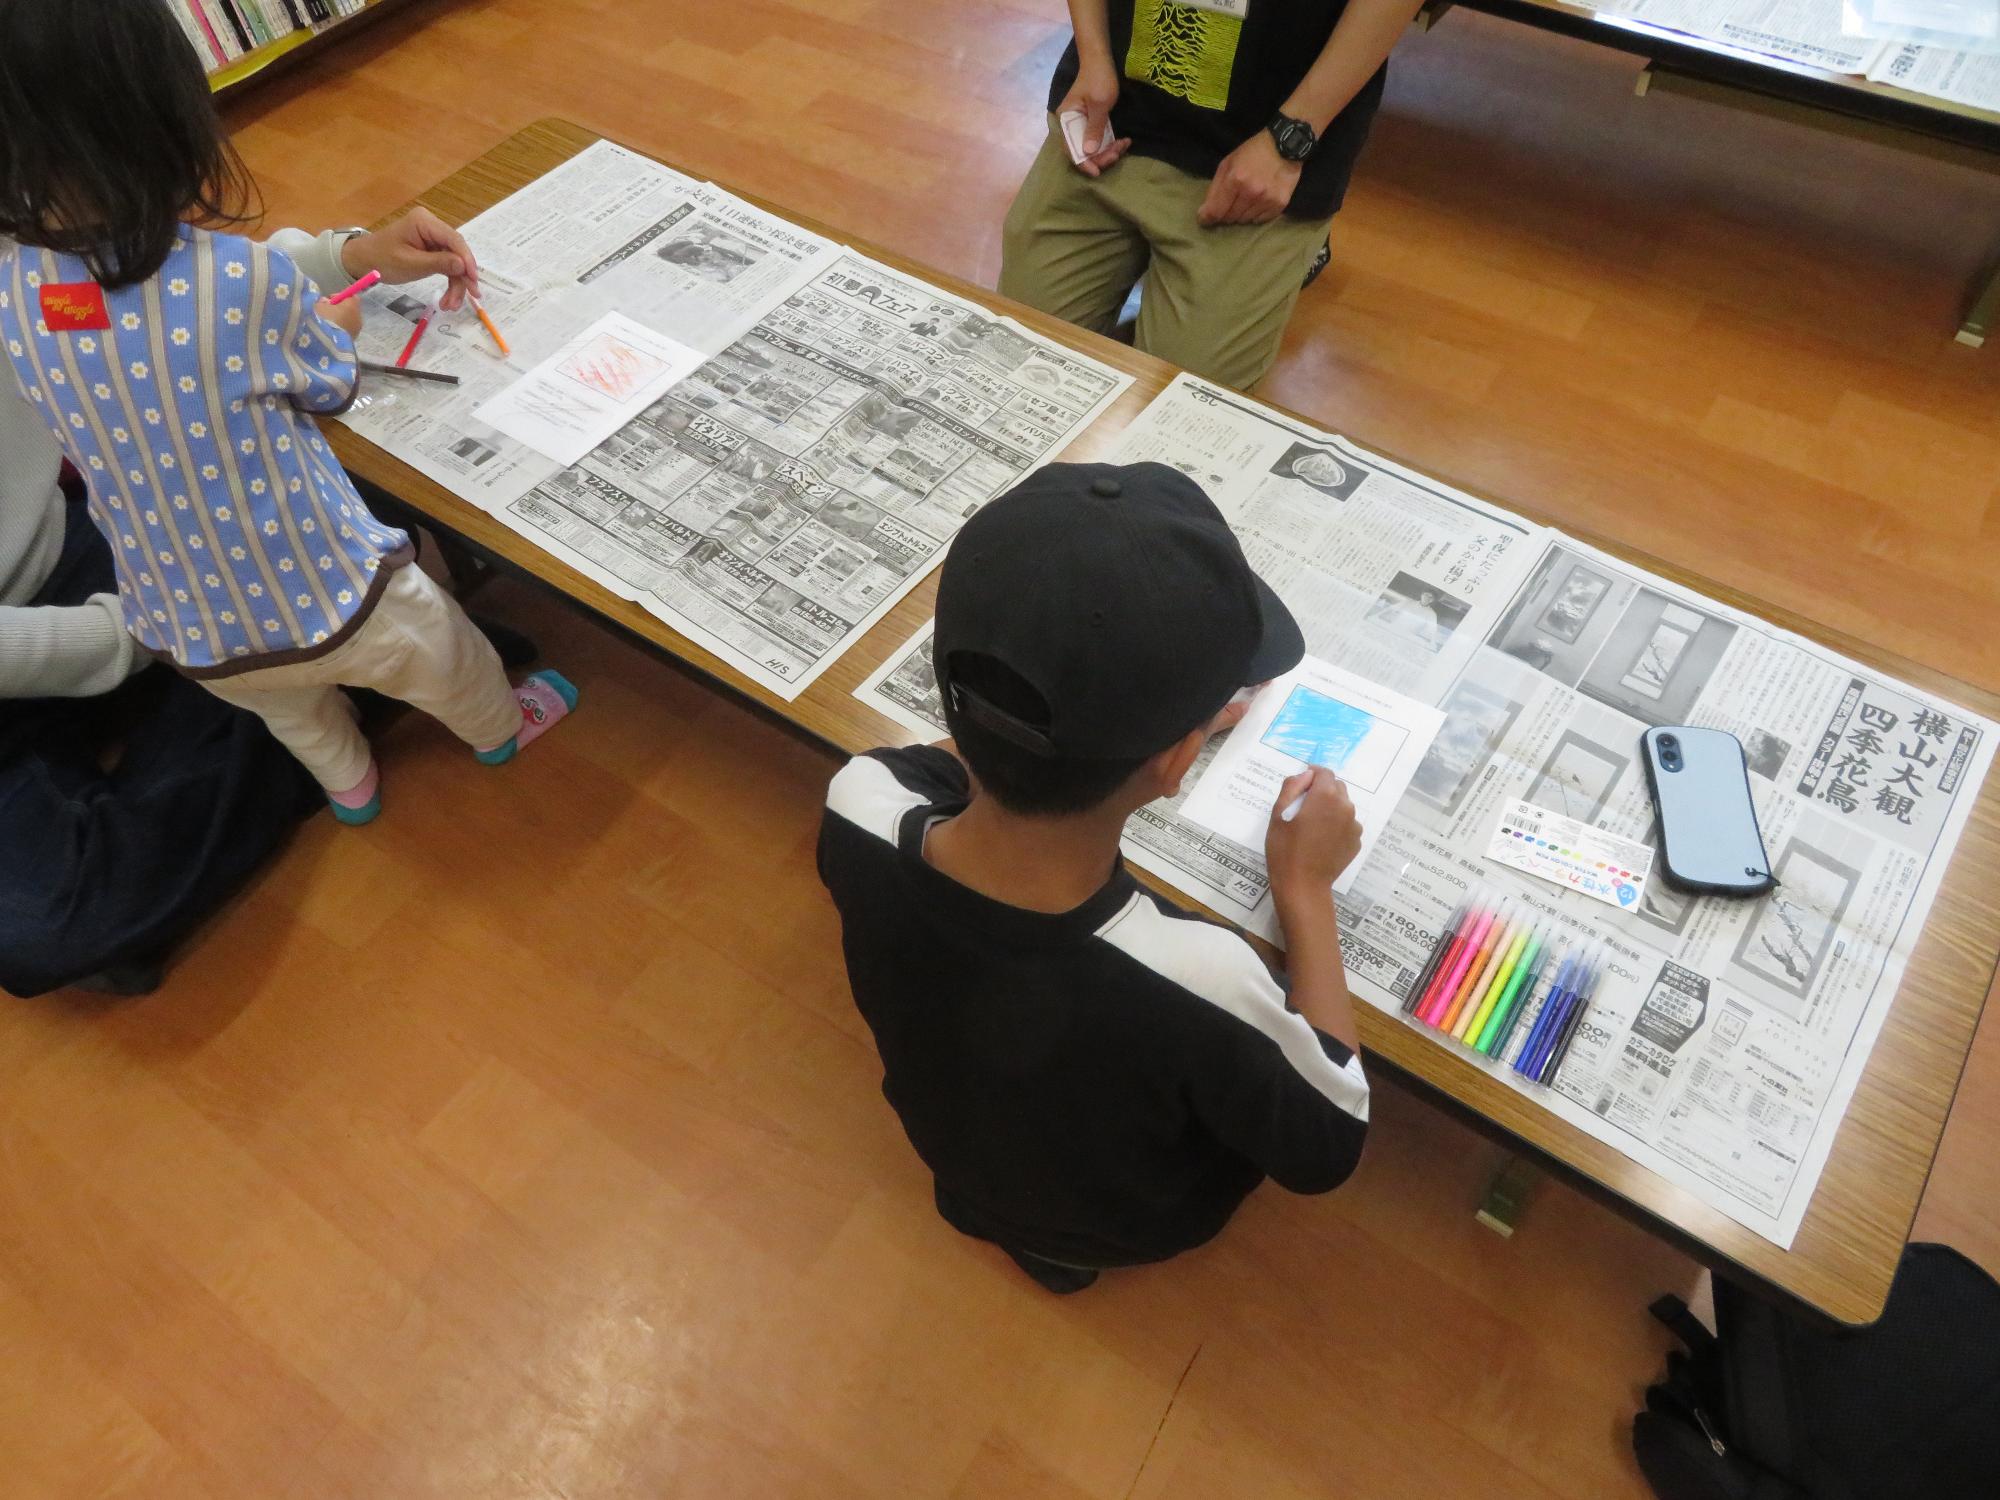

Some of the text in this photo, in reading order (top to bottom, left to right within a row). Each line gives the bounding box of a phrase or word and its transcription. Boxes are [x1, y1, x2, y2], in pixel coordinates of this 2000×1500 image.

[890, 358, 917, 378] ハワイ
[1191, 390, 1219, 407] くらし
[694, 420, 735, 447] イタリア
[588, 475, 623, 499] フランス
[781, 465, 827, 495] スペイン
[1442, 534, 1489, 586] 父のから揚げ
[1463, 532, 1514, 595] 聖夜にたっぷり
[808, 604, 838, 625] トルコ
[1816, 702, 1900, 814] 四季花鳥
[1872, 708, 1952, 826] 横山大観
[1628, 1035, 1677, 1069] カラーカタログ
